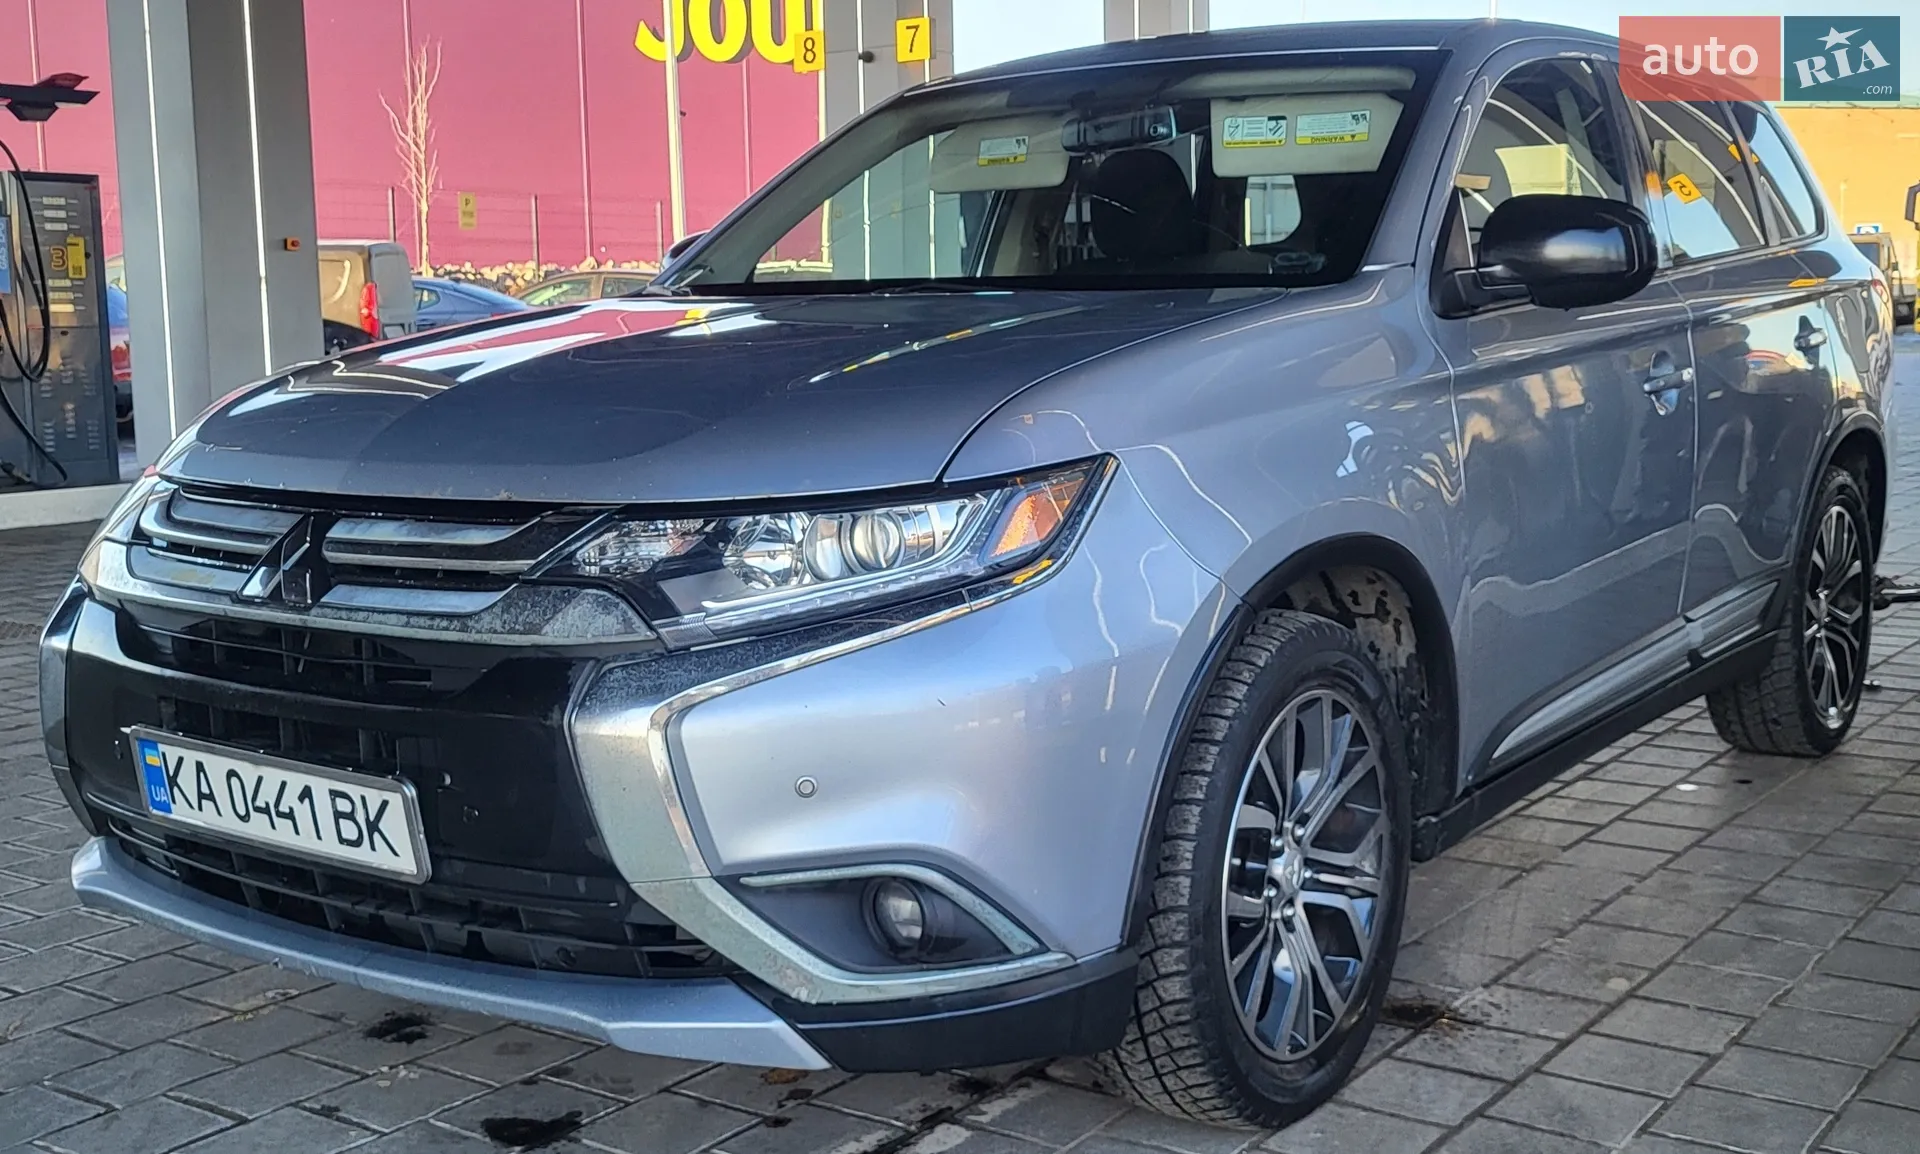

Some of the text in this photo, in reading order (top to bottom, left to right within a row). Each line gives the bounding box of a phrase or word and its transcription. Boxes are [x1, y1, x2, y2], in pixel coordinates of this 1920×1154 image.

[803, 36, 816, 64] 8
[905, 24, 920, 53] 7
[50, 246, 68, 271] 3
[151, 784, 169, 805] UA
[161, 751, 401, 858] KA 0441 BK
